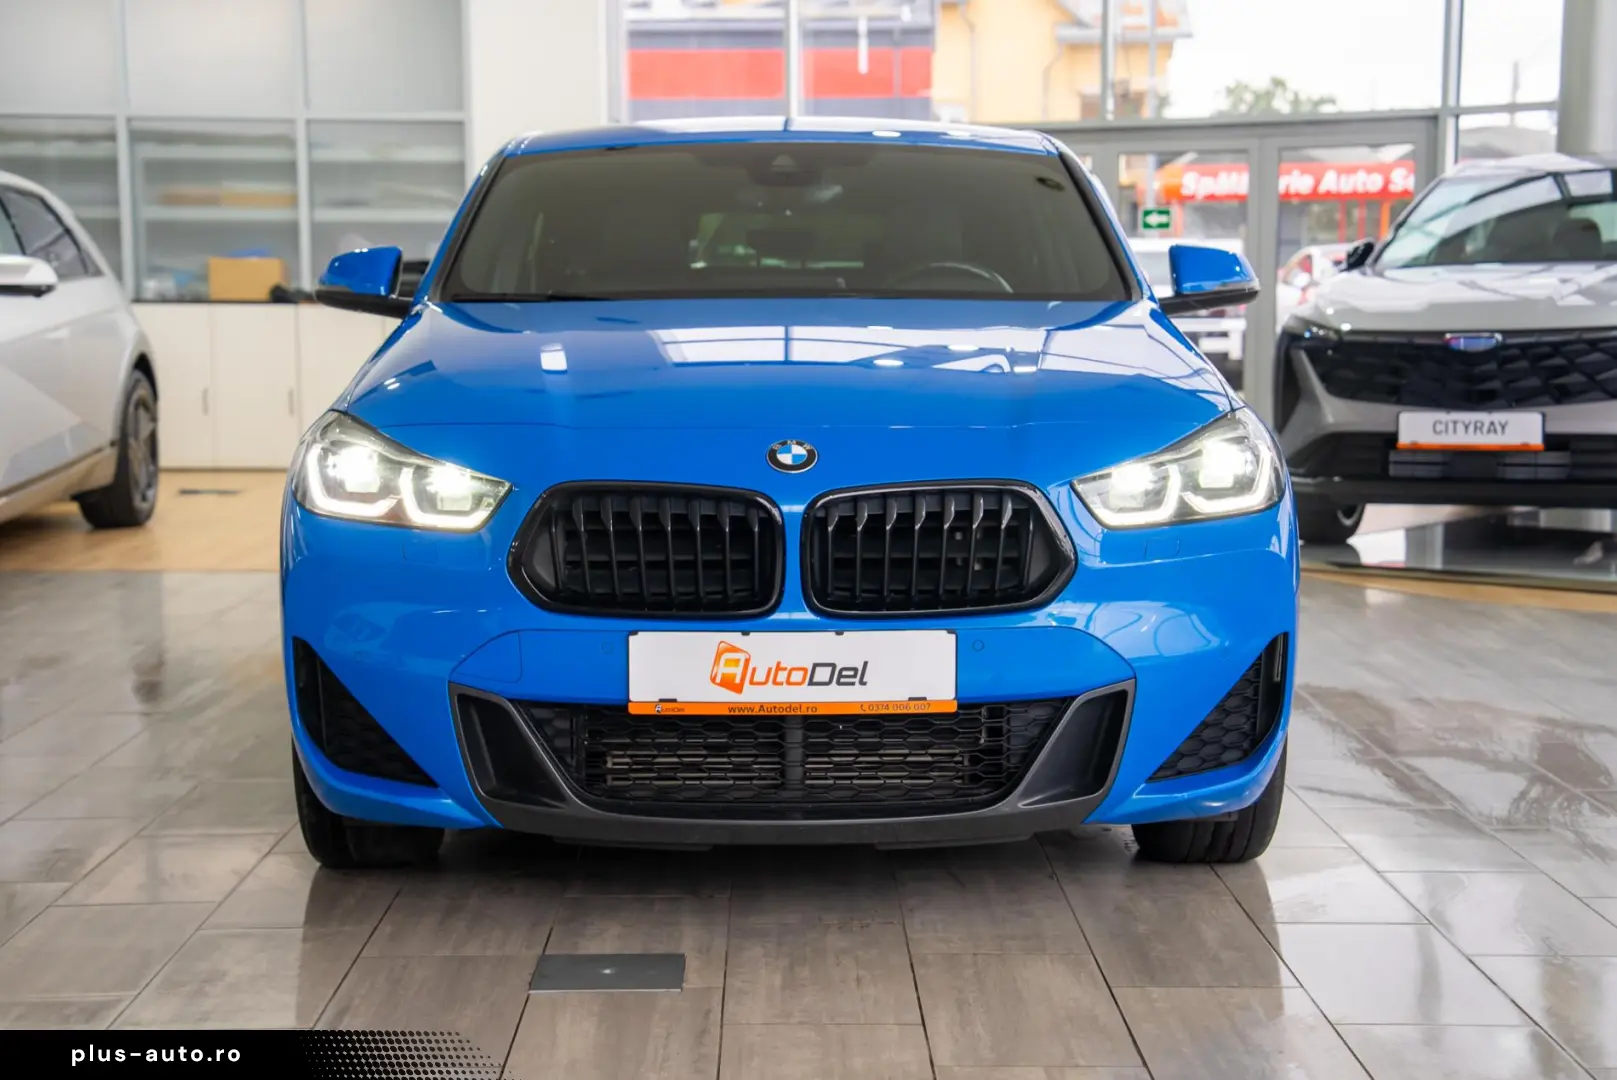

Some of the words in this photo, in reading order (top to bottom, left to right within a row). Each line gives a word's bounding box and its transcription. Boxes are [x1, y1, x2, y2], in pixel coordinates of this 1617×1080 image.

[1317, 168, 1383, 195] Auto
[1432, 419, 1509, 436] CITYRAY
[711, 646, 868, 690] AutoDel
[727, 703, 818, 714] www.Autodel.ro
[867, 703, 890, 712] 0374
